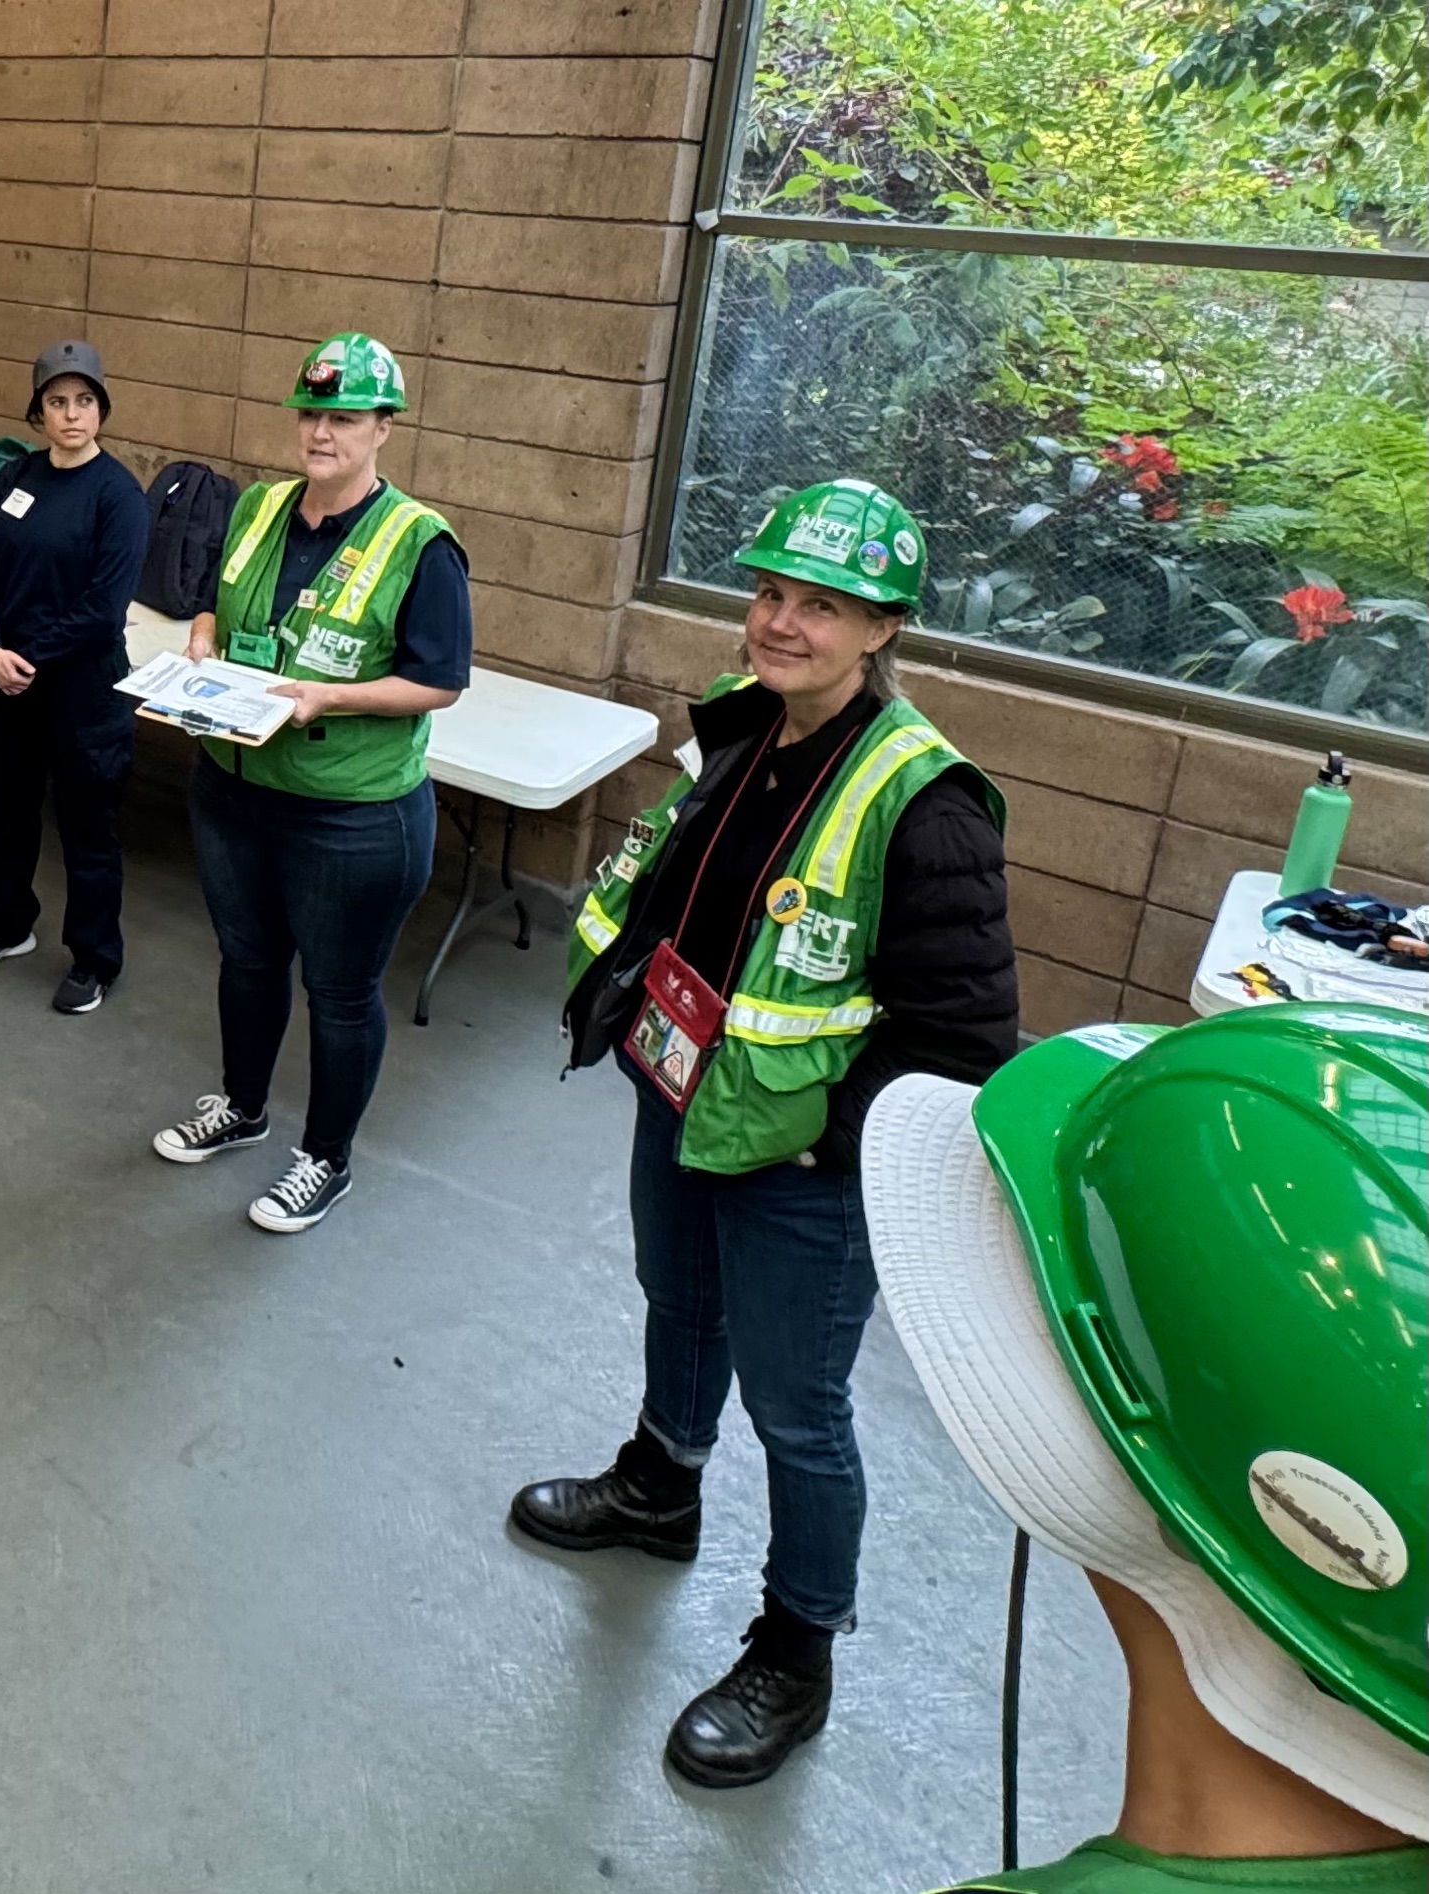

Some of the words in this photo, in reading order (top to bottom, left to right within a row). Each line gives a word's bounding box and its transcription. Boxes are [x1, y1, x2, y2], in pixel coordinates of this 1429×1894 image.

[796, 506, 857, 541] NERT
[307, 624, 367, 659] NERT
[794, 907, 857, 943] ERT
[1290, 1468, 1351, 1502] Treasure
[1353, 1503, 1385, 1541] Island
